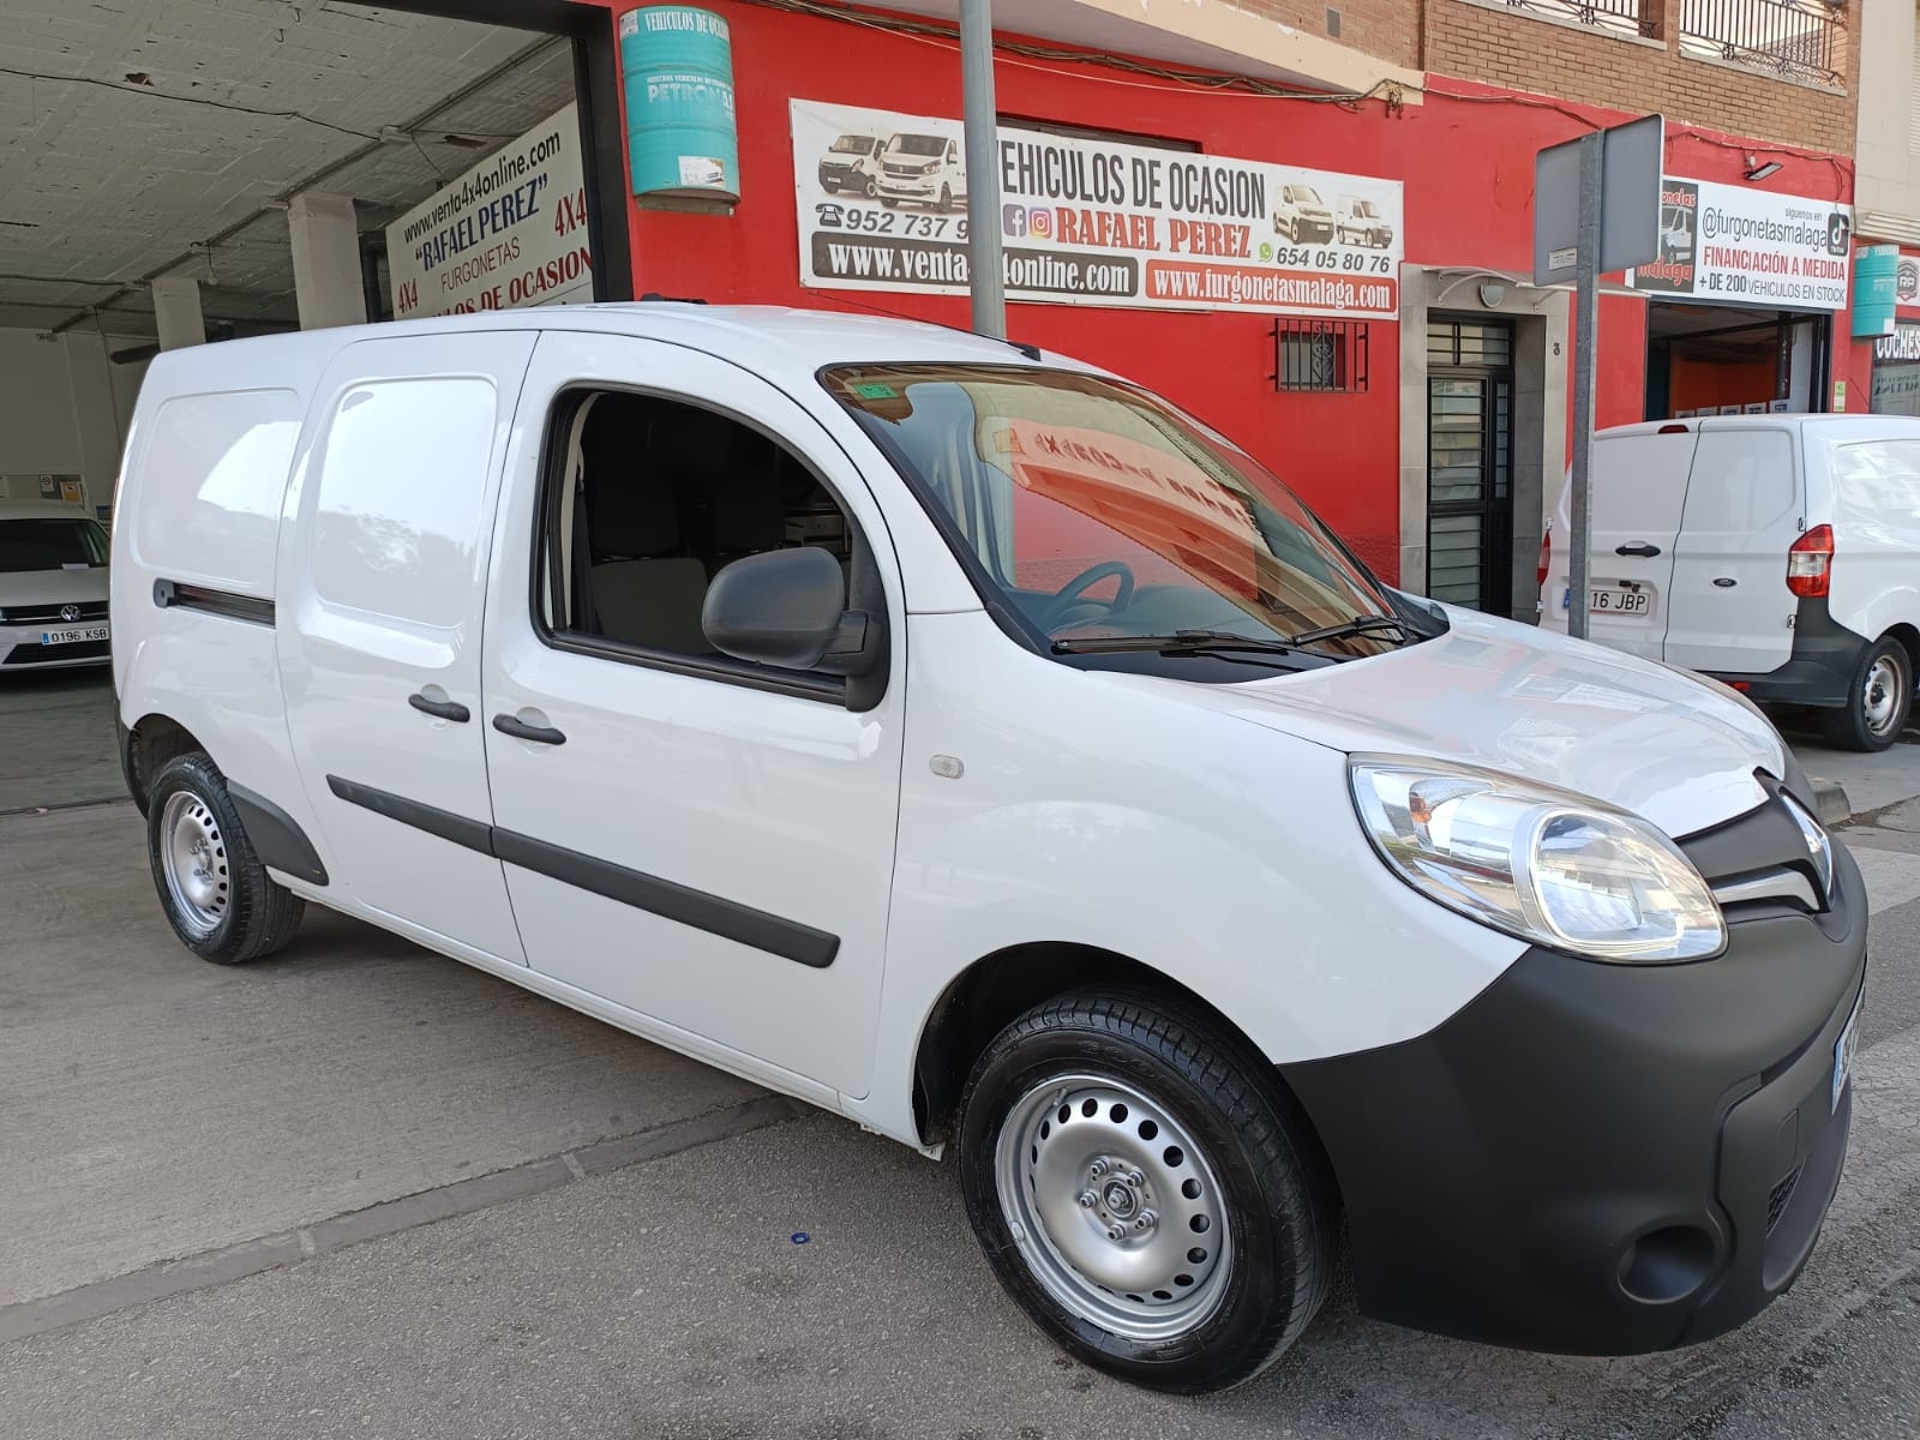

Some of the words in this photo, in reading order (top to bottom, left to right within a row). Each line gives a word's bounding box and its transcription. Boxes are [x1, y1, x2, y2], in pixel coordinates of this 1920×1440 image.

[644, 11, 694, 32] VEHICULOS
[696, 13, 708, 32] DE
[403, 131, 561, 244] www.venta4x4online.com
[997, 140, 1124, 206] EHICULOS
[1131, 157, 1162, 209] DE
[1169, 162, 1266, 219] OCASION
[1661, 187, 1697, 207] onetas
[555, 187, 587, 237] 4X4
[846, 208, 895, 234] 952
[904, 213, 948, 238] 737
[1702, 206, 1828, 252] @furgonetasmalaga
[1056, 206, 1160, 251] RAFAEL
[1169, 218, 1251, 258] PEREZ
[441, 236, 521, 293] FURGONETAS
[509, 246, 593, 304] OCASION
[828, 243, 1130, 293] www.ventaonline.com
[1277, 247, 1310, 267] 654
[1315, 250, 1337, 268] 05
[1343, 252, 1363, 271] 80
[1369, 255, 1390, 273] 76
[1703, 245, 1789, 275] FINANCIACIÓN
[1791, 257, 1800, 276] A
[1802, 258, 1846, 281] MEDIDA
[398, 278, 419, 314] 4X4
[1154, 268, 1391, 309] www.furgonetasmalaga.com
[1709, 273, 1723, 291] DE
[1726, 274, 1747, 293] 200
[1748, 280, 1800, 299] VEHICULOS
[1802, 285, 1815, 300] EN
[1816, 287, 1846, 302] STOCK
[1592, 592, 1610, 608] 16
[1615, 594, 1646, 611] JBP
[52, 630, 82, 643] 0196
[86, 628, 108, 640] KSB
